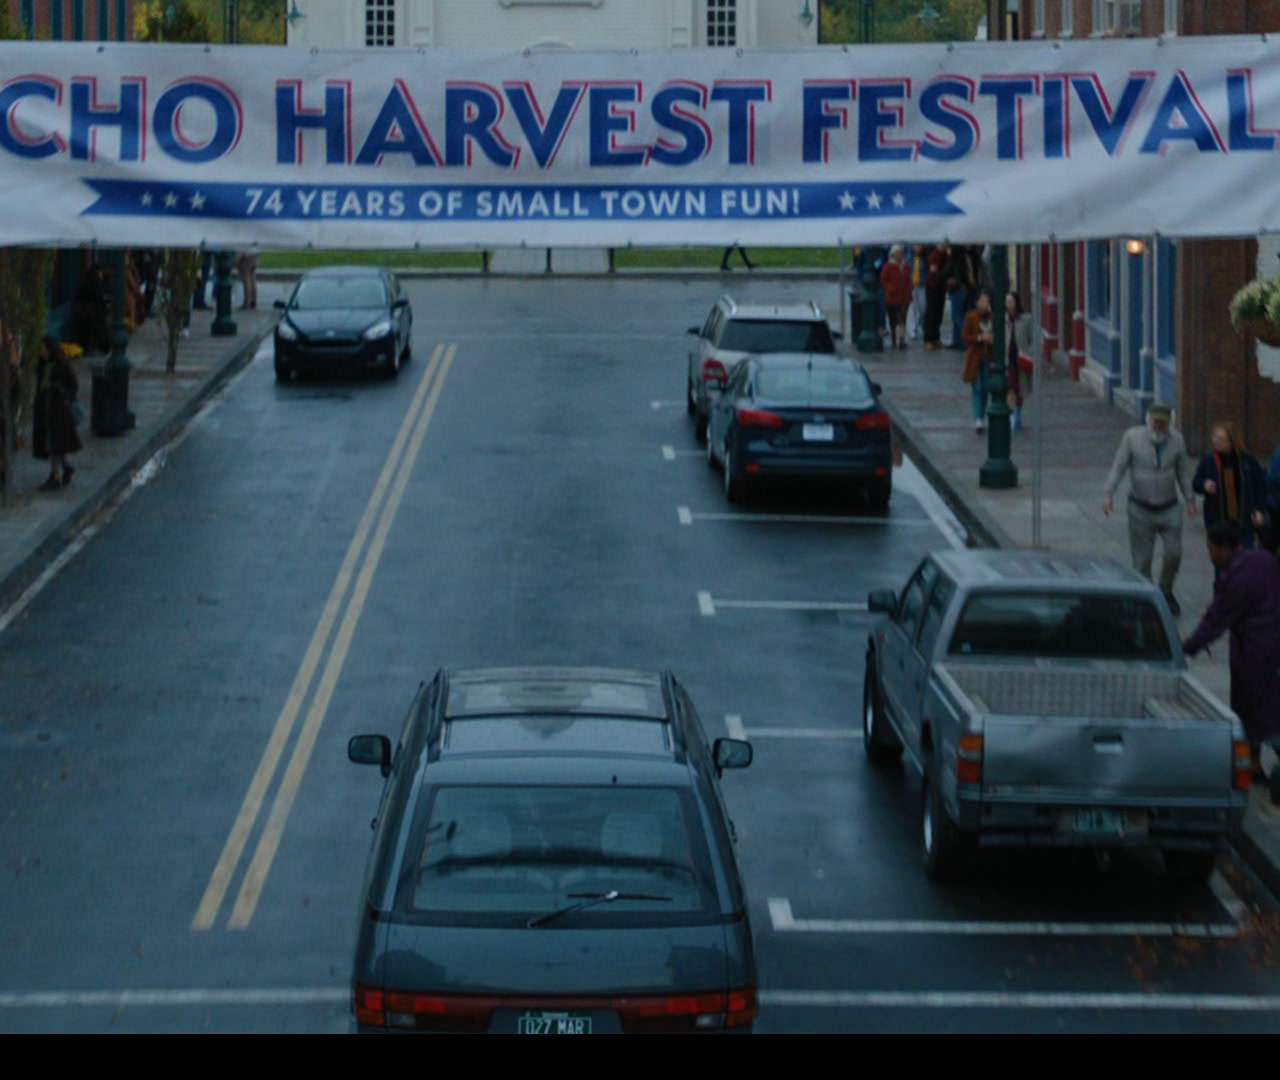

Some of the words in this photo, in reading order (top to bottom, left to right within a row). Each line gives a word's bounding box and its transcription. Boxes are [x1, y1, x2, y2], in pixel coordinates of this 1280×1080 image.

[275, 77, 773, 169] HARVEST
[245, 188, 284, 217] 74
[296, 189, 406, 218] YEARS
[418, 190, 463, 218] OF
[475, 189, 590, 218] SMALL
[600, 189, 707, 218] TOWN
[720, 187, 801, 217] FUN!
